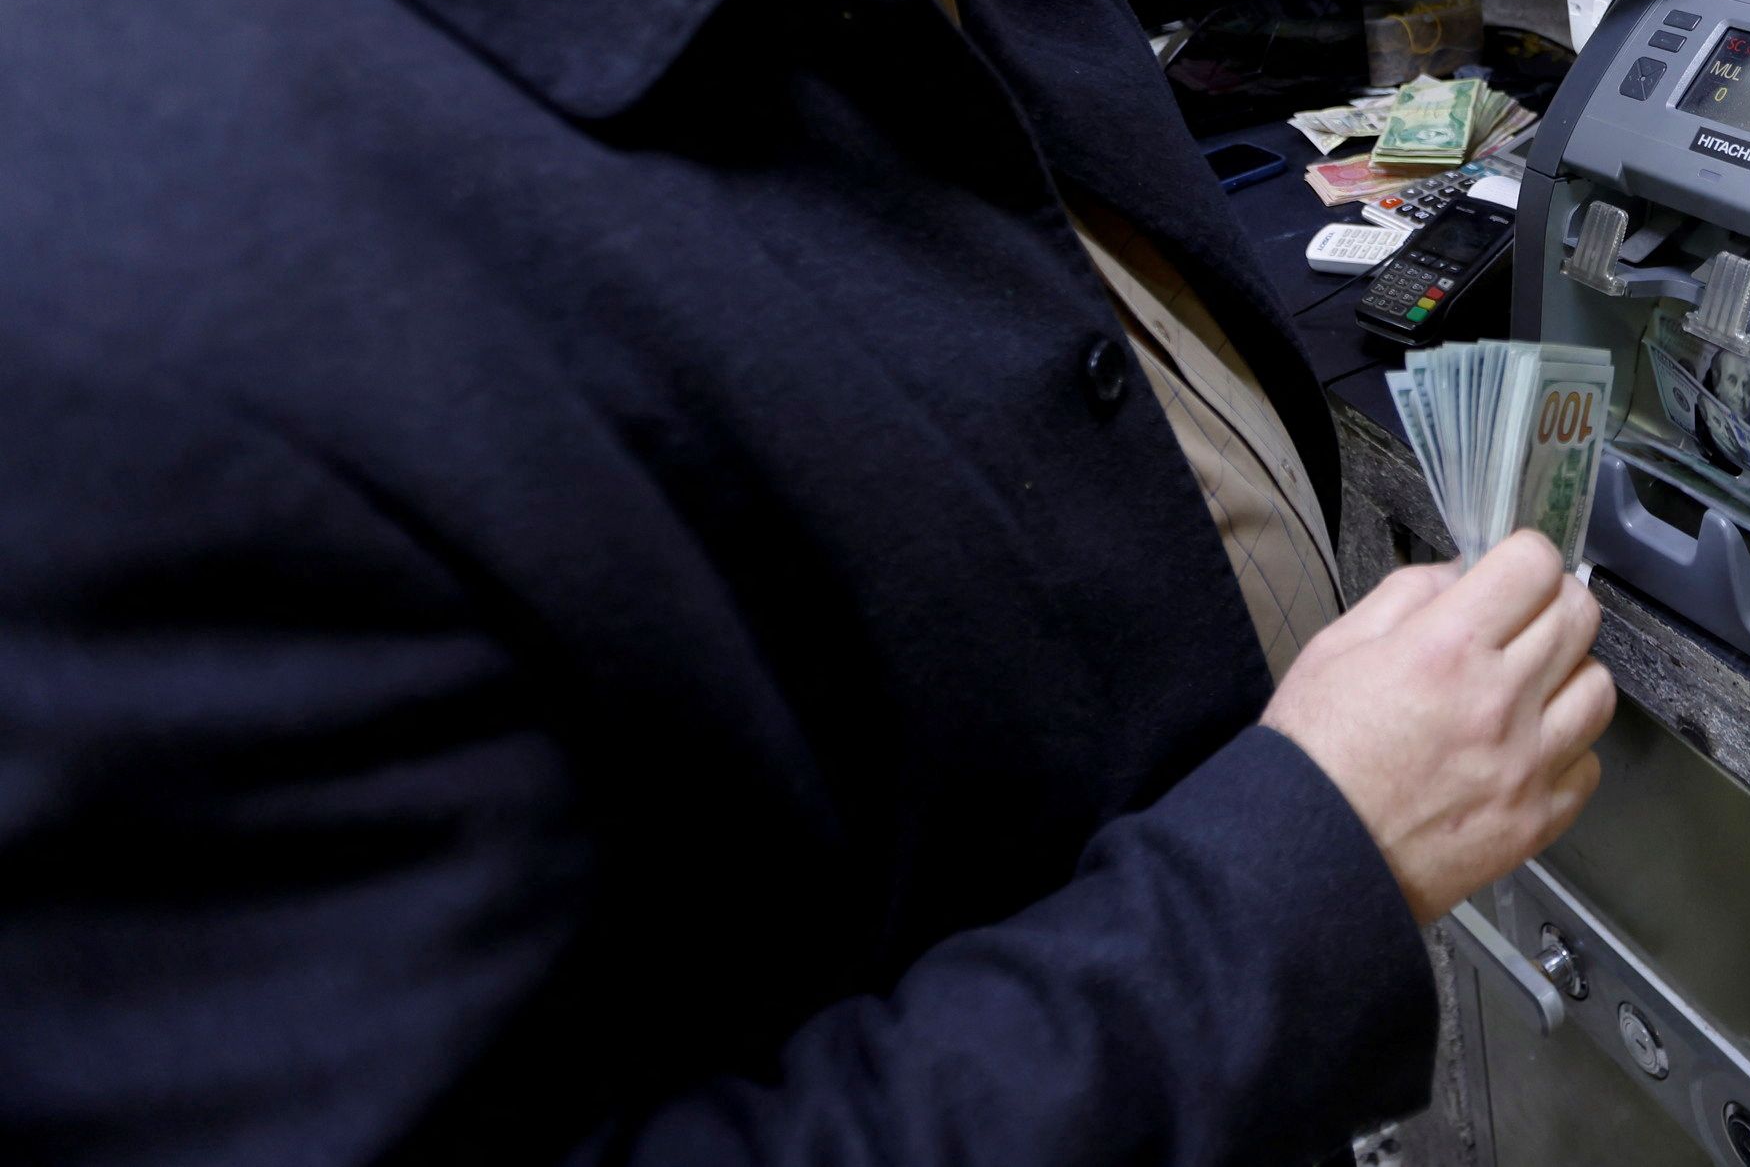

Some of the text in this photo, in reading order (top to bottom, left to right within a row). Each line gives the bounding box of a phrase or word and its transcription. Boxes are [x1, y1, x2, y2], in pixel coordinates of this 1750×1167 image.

[1727, 37, 1746, 52] SC
[1710, 60, 1743, 81] MUL
[1714, 86, 1728, 103] 0
[1537, 390, 1594, 445] 100
